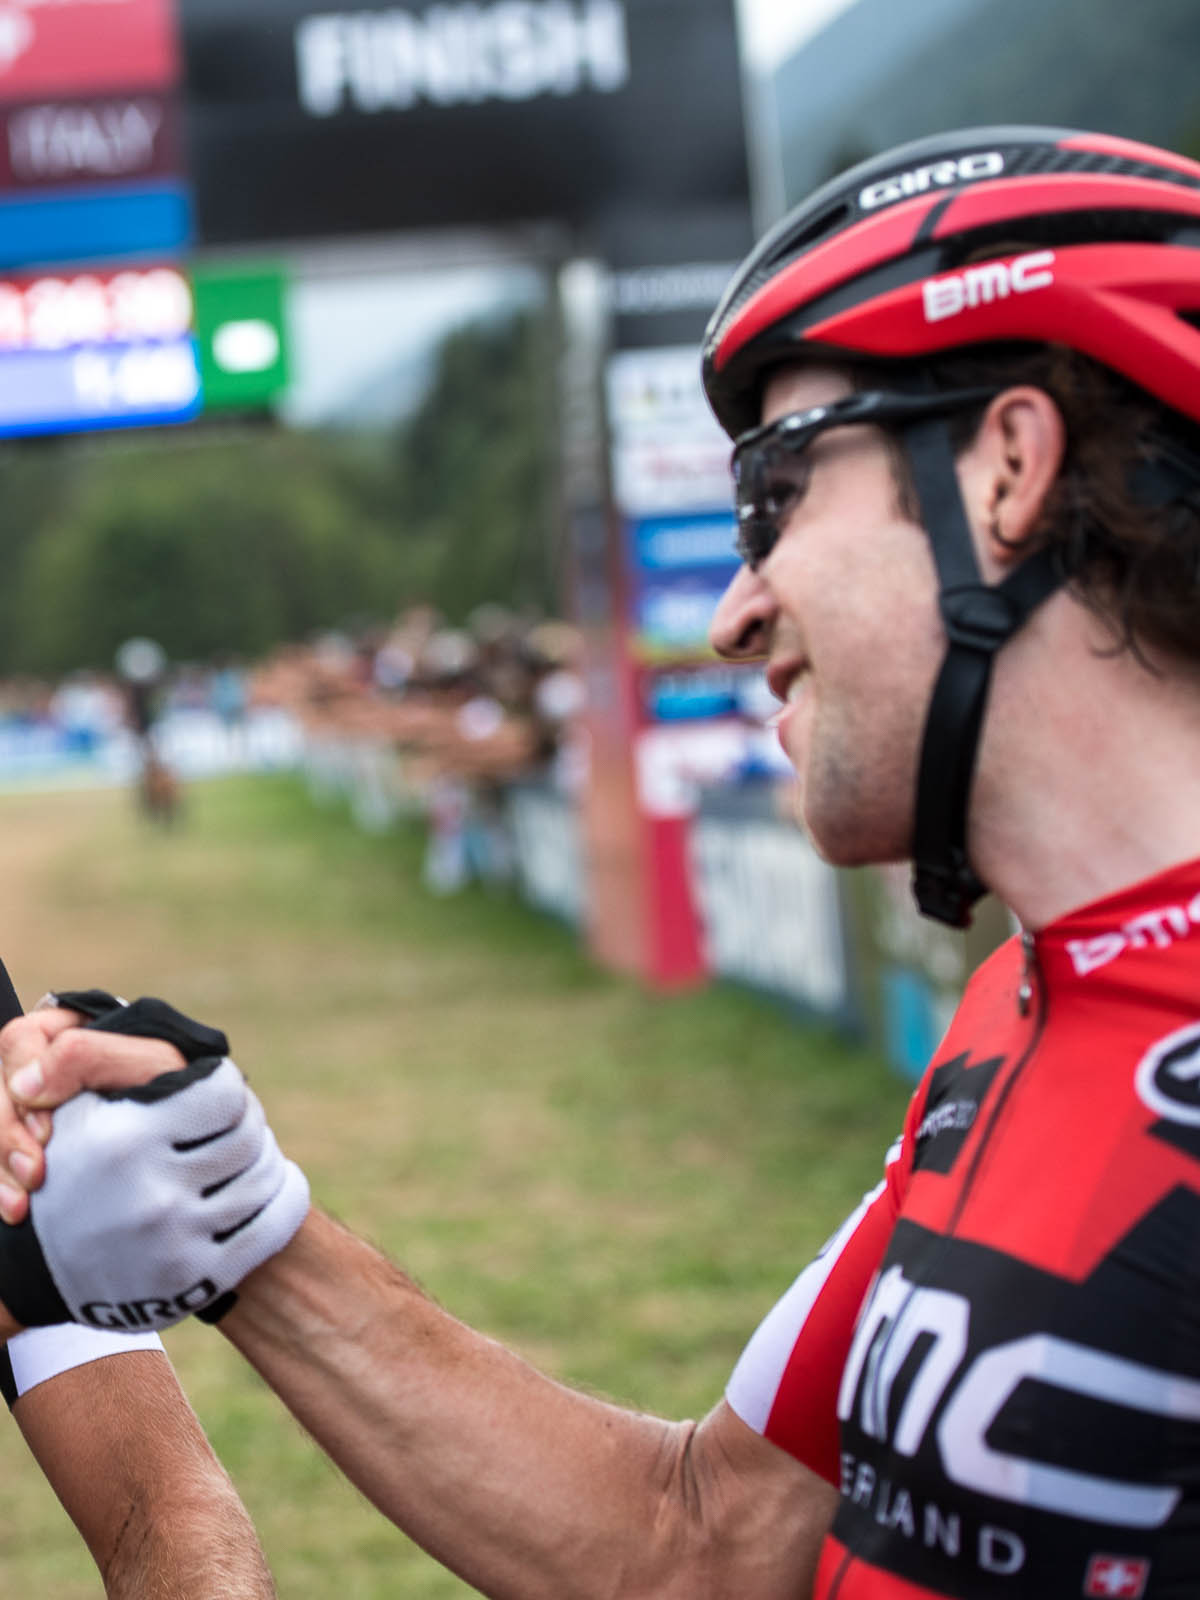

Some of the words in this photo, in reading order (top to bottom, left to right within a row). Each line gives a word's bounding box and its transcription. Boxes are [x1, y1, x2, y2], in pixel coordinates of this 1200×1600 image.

[297, 0, 627, 116] FINISH
[859, 151, 1004, 209] GIRO
[922, 250, 1056, 323] BMC
[80, 1278, 217, 1329] GIRO
